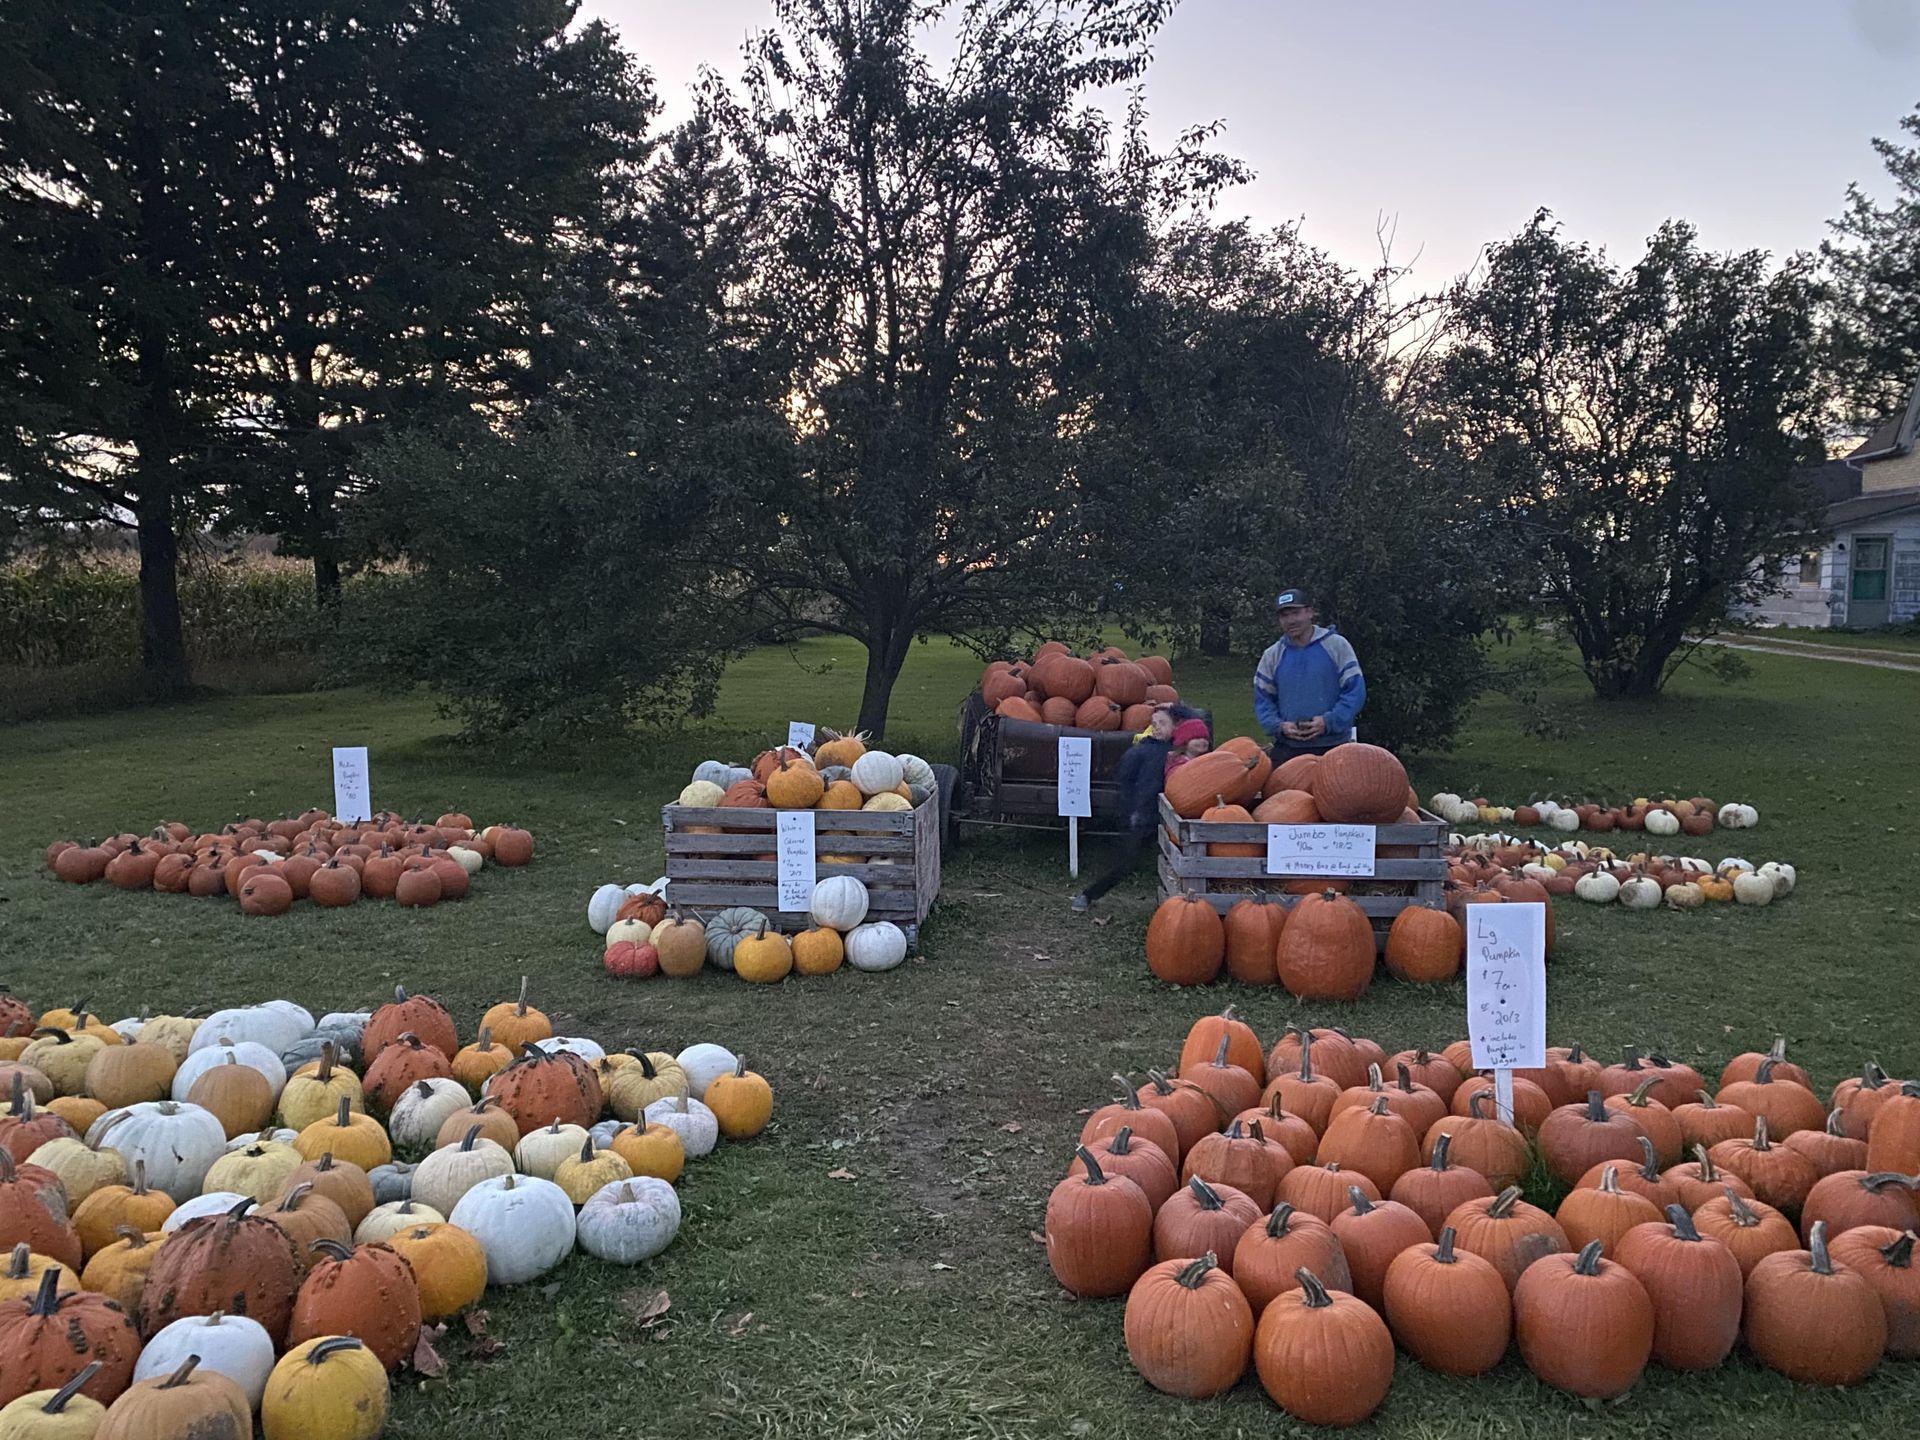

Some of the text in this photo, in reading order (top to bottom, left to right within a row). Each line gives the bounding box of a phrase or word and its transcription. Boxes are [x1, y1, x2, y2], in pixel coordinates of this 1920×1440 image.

[1288, 828, 1326, 840] Jumbo
[1478, 918, 1498, 945] Lg
[1482, 946, 1521, 964] Pumpkin
[1491, 1057, 1518, 1066] Wagon
